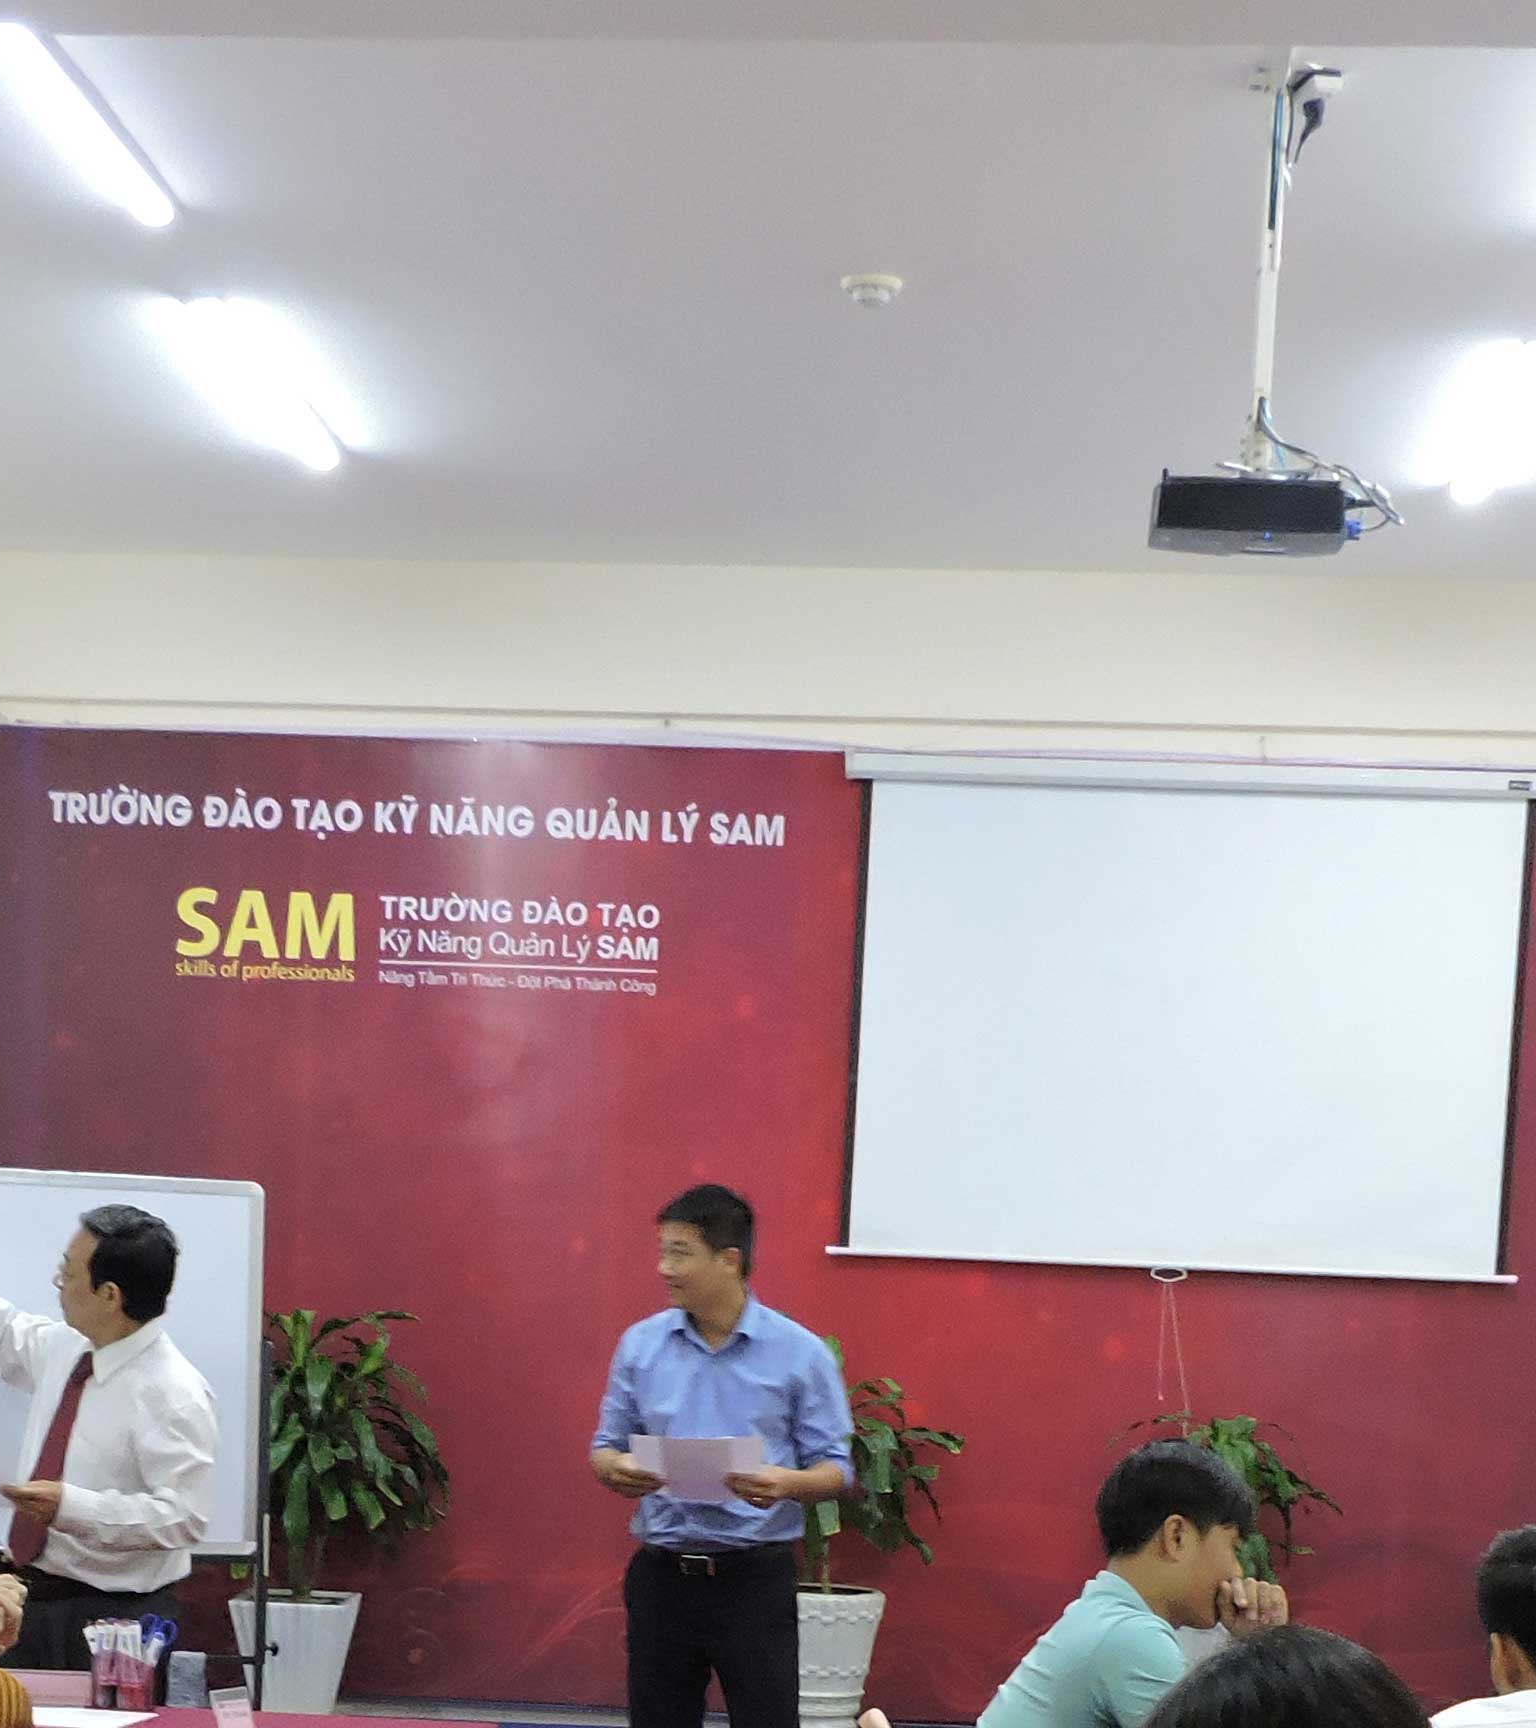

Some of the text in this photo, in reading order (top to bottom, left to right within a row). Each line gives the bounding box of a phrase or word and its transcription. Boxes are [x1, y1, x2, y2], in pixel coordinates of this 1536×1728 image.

[48, 784, 785, 847] TRƯỜNG ĐÀO TẠO KỸ NĂNG QUẢN LÝ SAM
[176, 887, 356, 961] SAM
[379, 892, 661, 933] TRƯỜNG ĐÀO TẠO
[379, 927, 412, 958] Kỹ
[417, 929, 482, 960] Năng
[489, 931, 555, 957] Quản
[597, 935, 660, 961] SAM
[175, 959, 356, 982] skills of professionals
